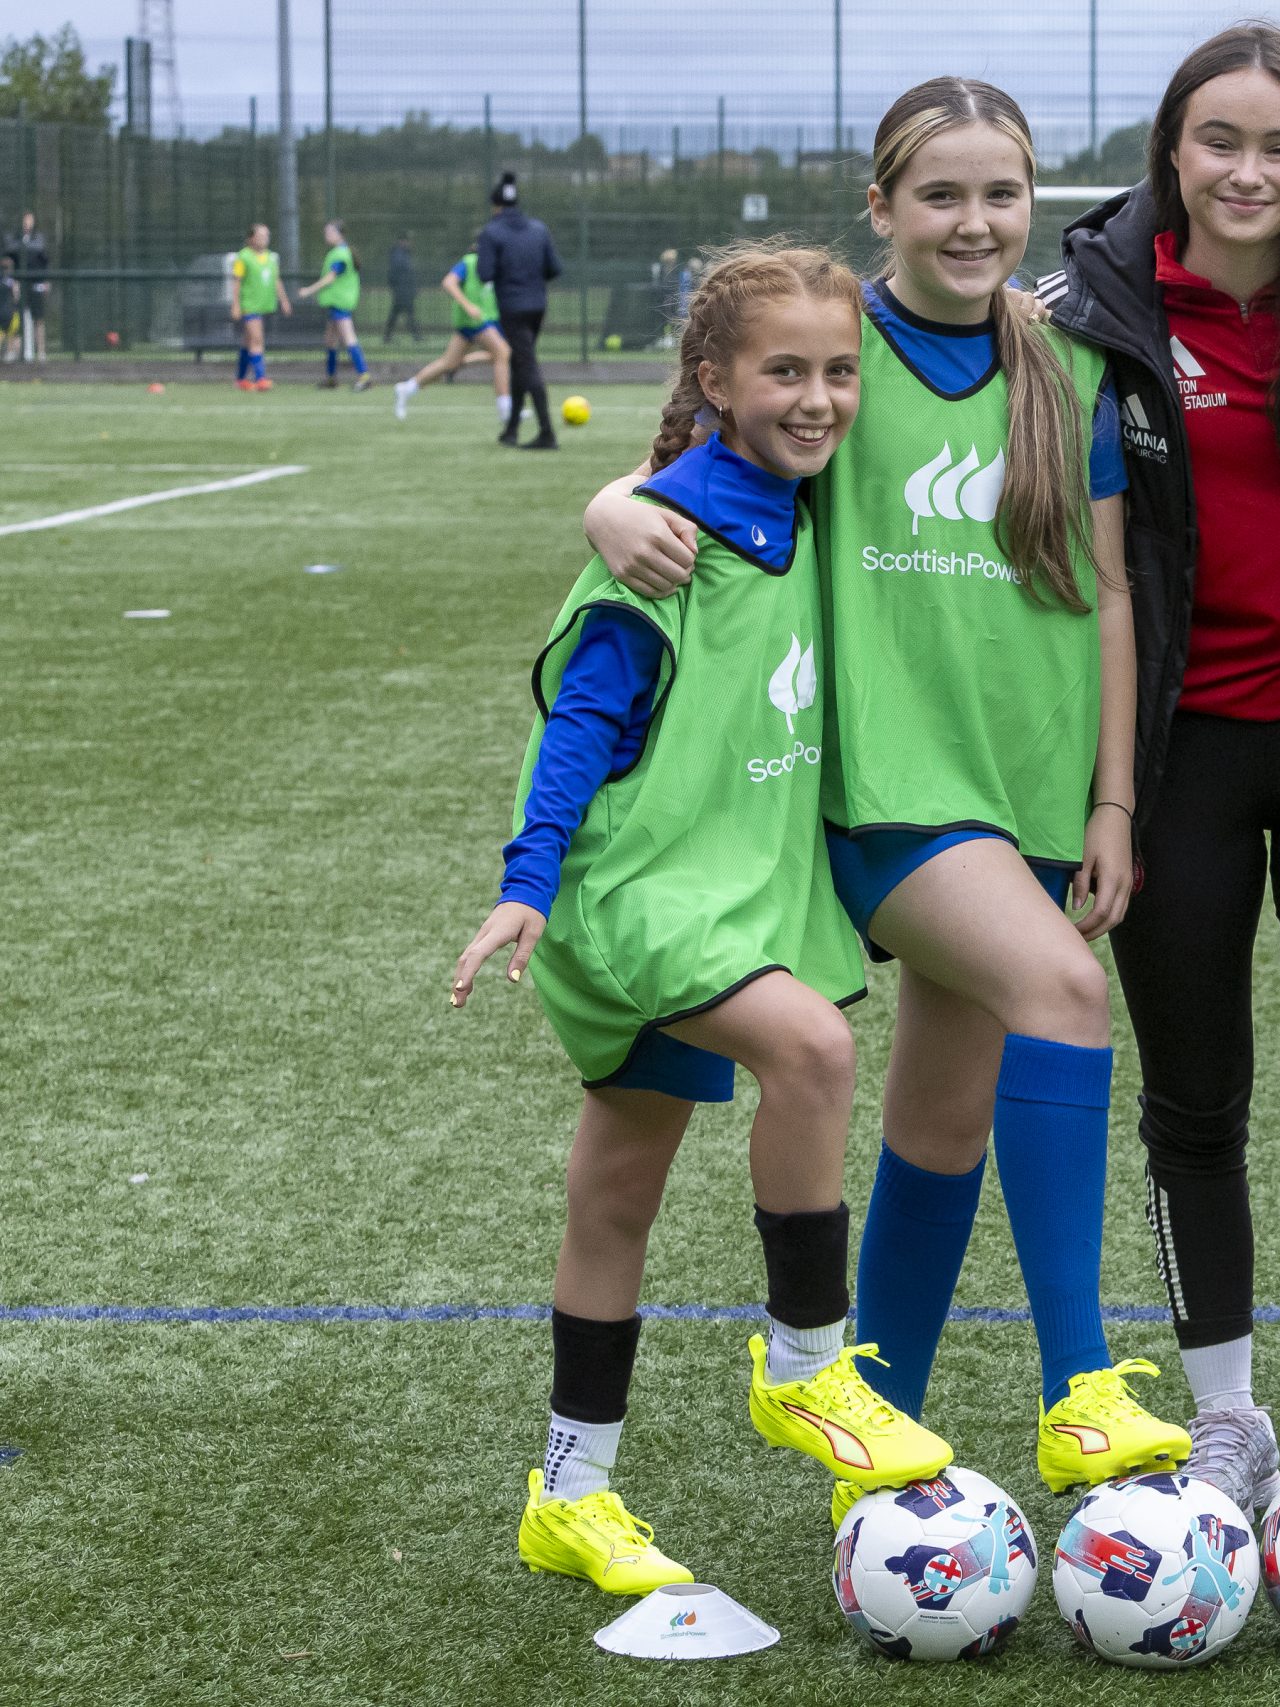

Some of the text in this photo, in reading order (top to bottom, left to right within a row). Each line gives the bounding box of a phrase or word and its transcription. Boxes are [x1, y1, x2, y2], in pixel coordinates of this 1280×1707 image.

[1177, 380, 1198, 394] TON
[1184, 393, 1228, 410] STADIUM
[861, 545, 1023, 585] ScottishPowe
